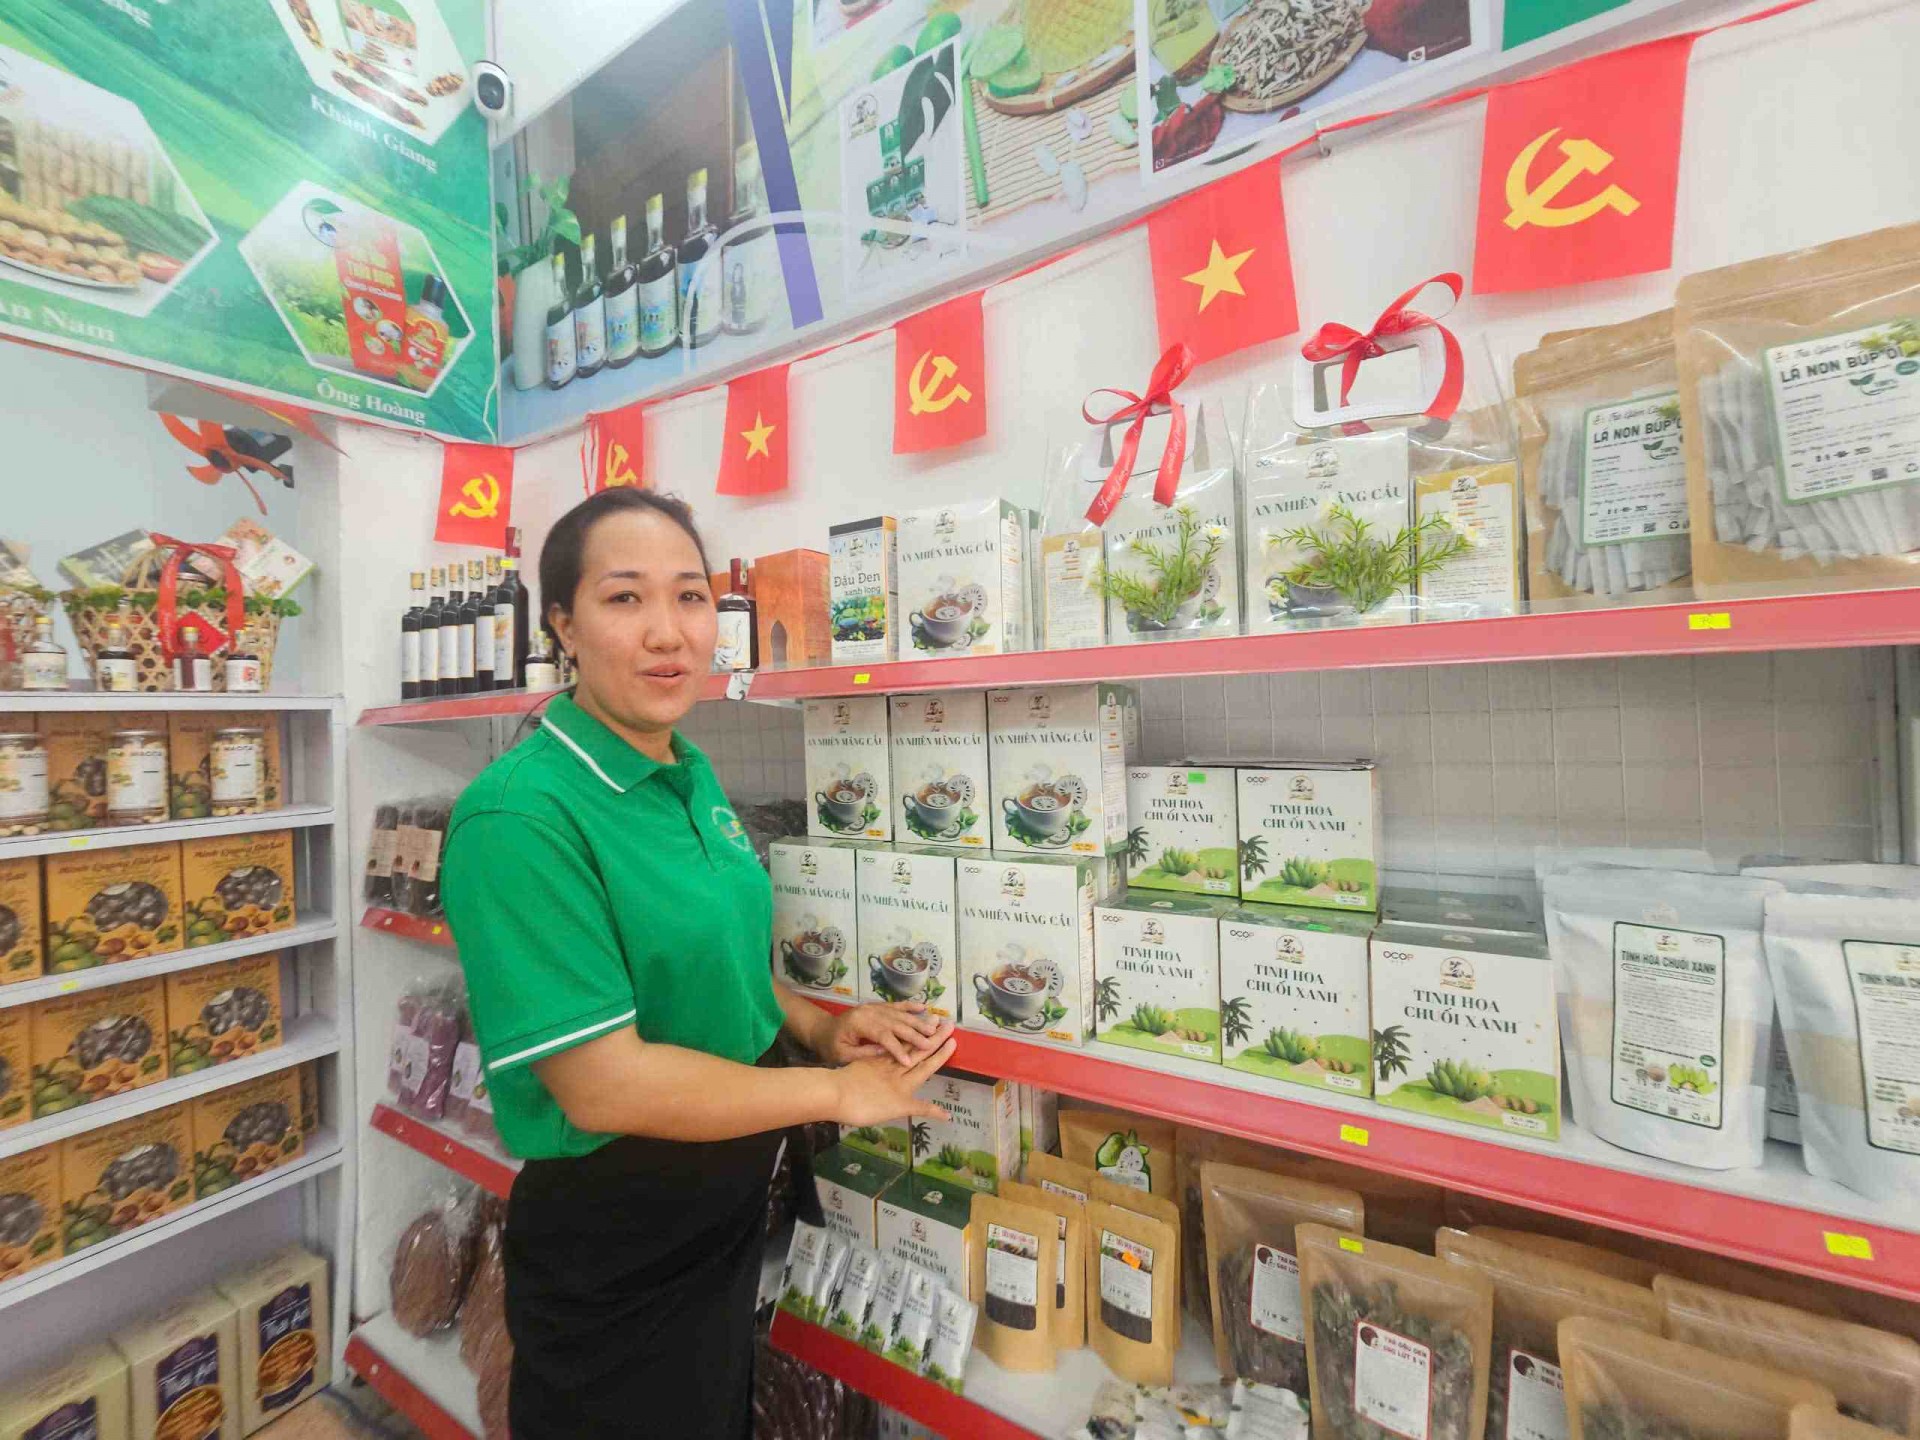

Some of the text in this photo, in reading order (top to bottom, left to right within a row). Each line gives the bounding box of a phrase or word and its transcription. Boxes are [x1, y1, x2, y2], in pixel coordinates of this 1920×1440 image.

[383, 132, 438, 174] Giang
[42, 305, 115, 342] Nam
[1806, 359, 1842, 378] NON
[1847, 350, 1879, 369] BÚP
[317, 378, 426, 427] Ông Hoàng
[1613, 424, 1641, 441] NON
[1645, 417, 1672, 434] BÚP
[1336, 489, 1367, 505] ÃNG
[857, 572, 881, 584] Đen
[1144, 808, 1180, 822] CHUỐI
[1151, 798, 1204, 811] TINH HOA
[1270, 803, 1334, 817] TINH HOA
[1262, 815, 1346, 832] CHUỐI XANH
[1121, 945, 1182, 963] TINH HOA
[1382, 949, 1415, 961] OCOP
[1115, 959, 1194, 979] CHUỐI XANH
[1253, 963, 1325, 985] TINH HOA
[1246, 978, 1338, 1004] CHUỐI XANH
[1413, 988, 1501, 1014] TINH HOA
[1403, 1005, 1518, 1035] CHUỐI XANH
